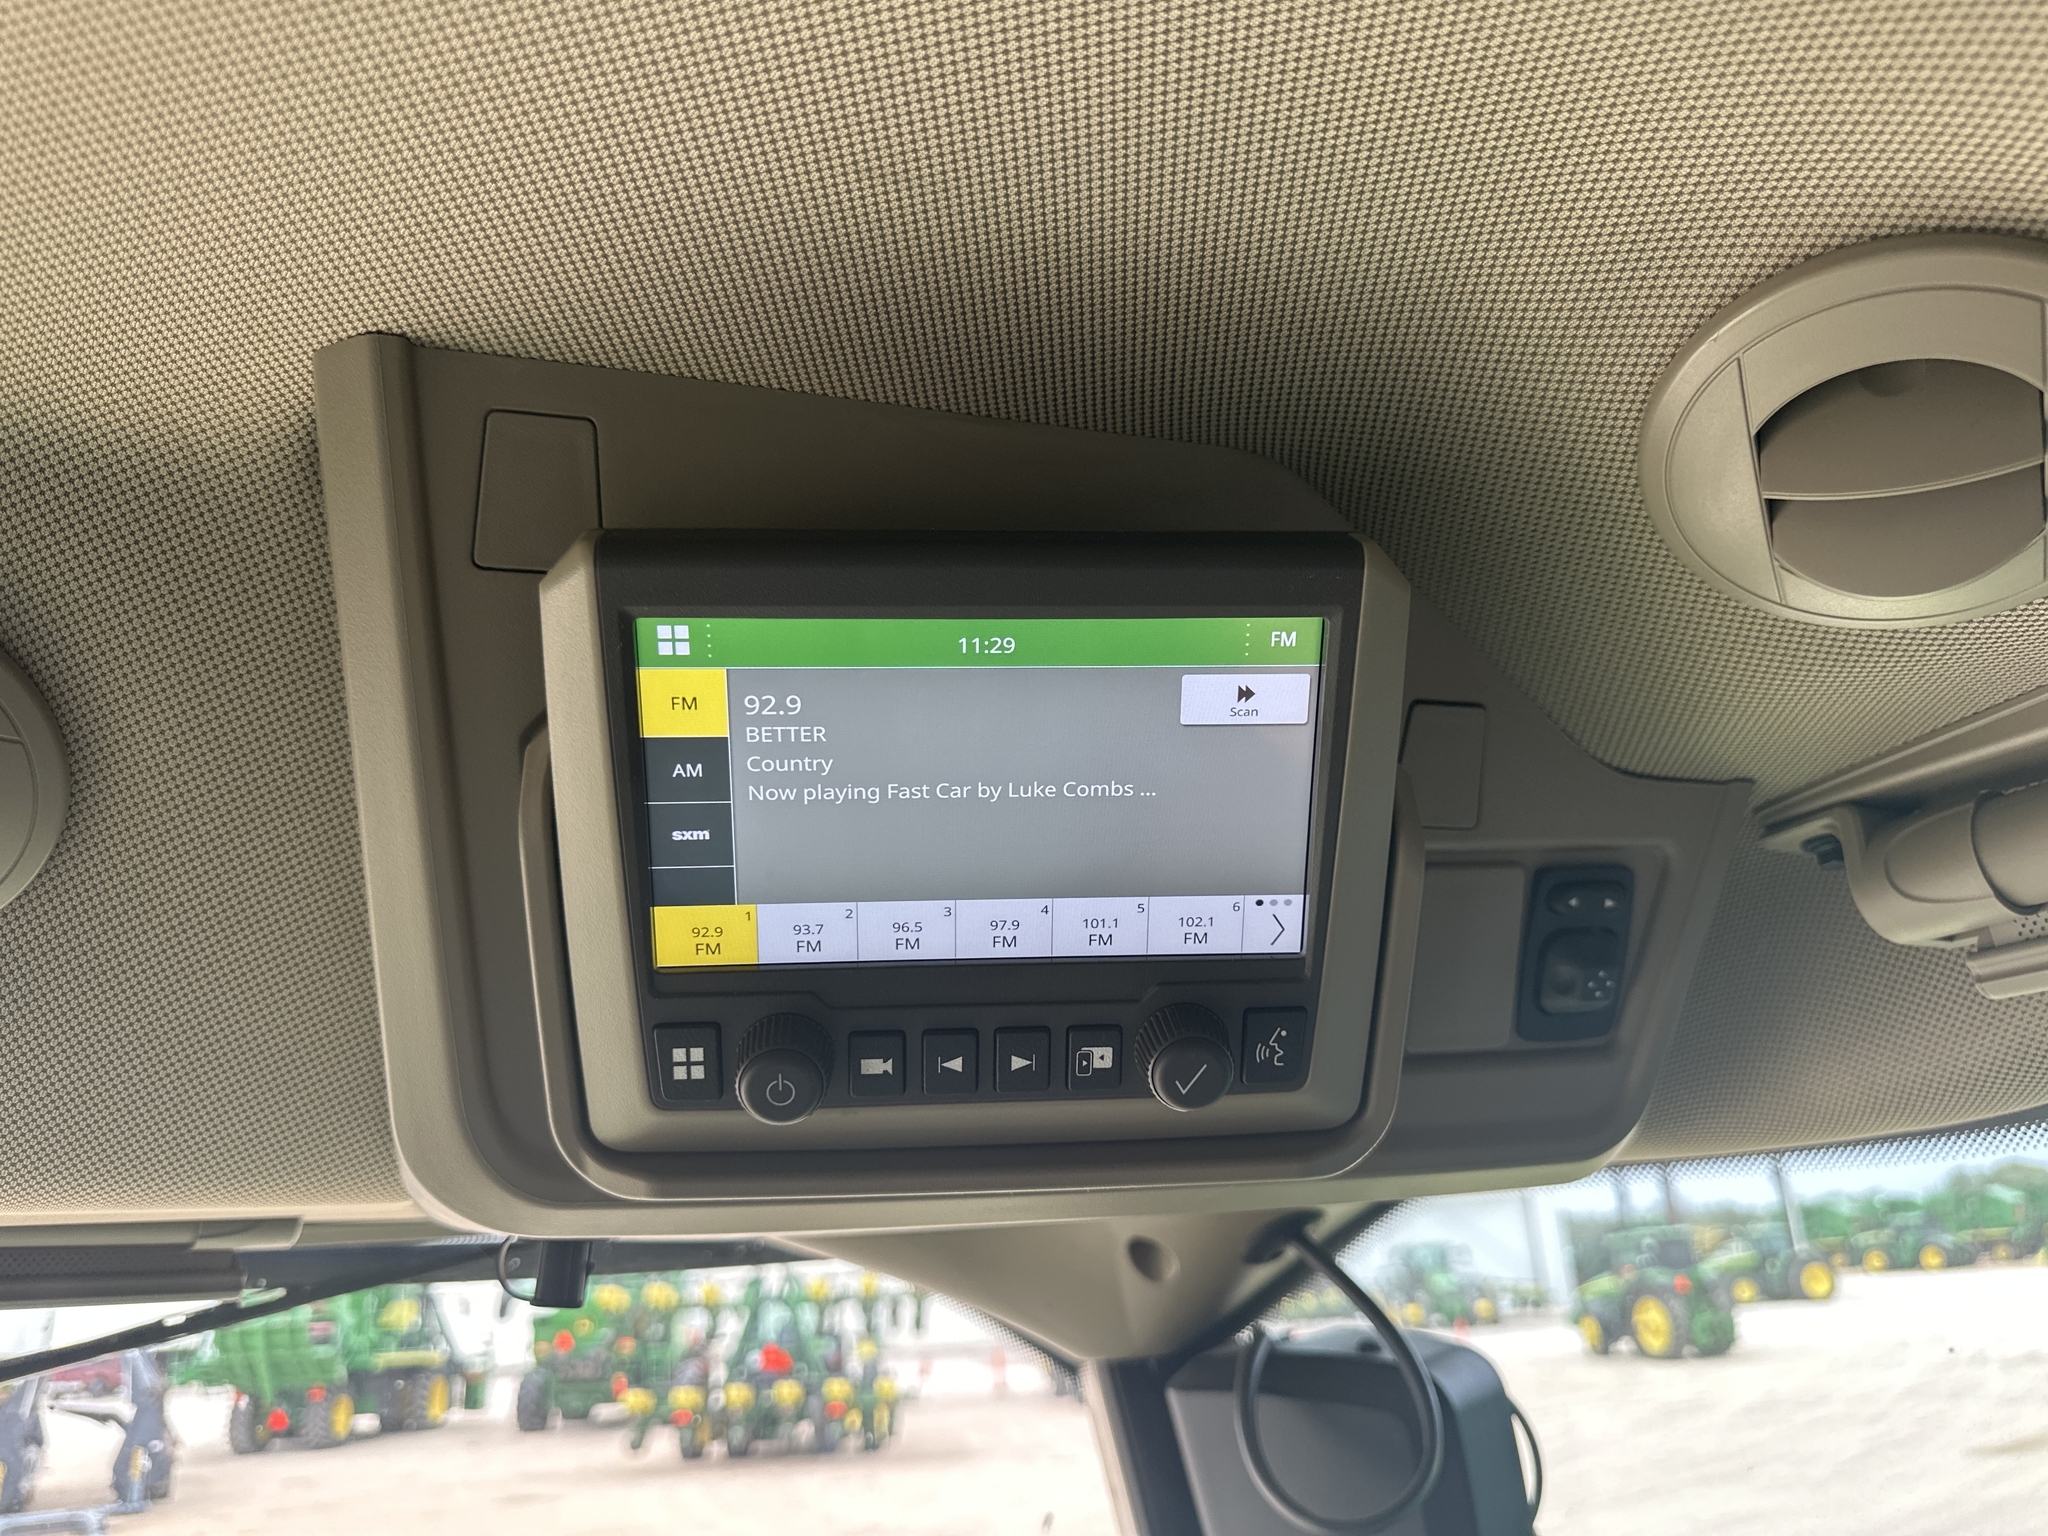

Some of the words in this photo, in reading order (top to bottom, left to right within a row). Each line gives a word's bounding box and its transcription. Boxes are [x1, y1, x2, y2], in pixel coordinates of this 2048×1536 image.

[958, 636, 1016, 654] 11:29
[1270, 630, 1297, 648] FM
[671, 696, 698, 711] FM
[743, 694, 802, 716] 92.9
[1229, 706, 1259, 717] Scan
[745, 726, 827, 743] BETTER
[672, 763, 703, 778] AM
[746, 755, 834, 776] Country
[748, 785, 797, 801] Now
[803, 783, 880, 805] playing
[887, 783, 930, 799] Fast
[936, 782, 972, 799] Car
[978, 781, 1003, 803] by
[1008, 780, 1057, 798] Luke
[1063, 780, 1134, 797] Combs
[671, 829, 711, 841] sxm
[943, 906, 952, 917] 3
[1040, 904, 1050, 915] 4
[1137, 903, 1145, 914] 5
[1232, 901, 1241, 912] 6
[745, 911, 751, 922] 1
[845, 908, 854, 919] 2
[892, 921, 923, 933] 96.5
[989, 919, 1020, 931] 97.9
[1082, 917, 1118, 929] 101.1
[1178, 916, 1214, 928] 102.1
[691, 926, 724, 938] 92.9
[792, 923, 824, 936] 93.7
[895, 937, 920, 951] FM
[992, 935, 1017, 948] FM
[1088, 933, 1113, 947] FM
[1183, 932, 1208, 945] FM
[695, 942, 722, 956] FM
[796, 939, 822, 953] FM
